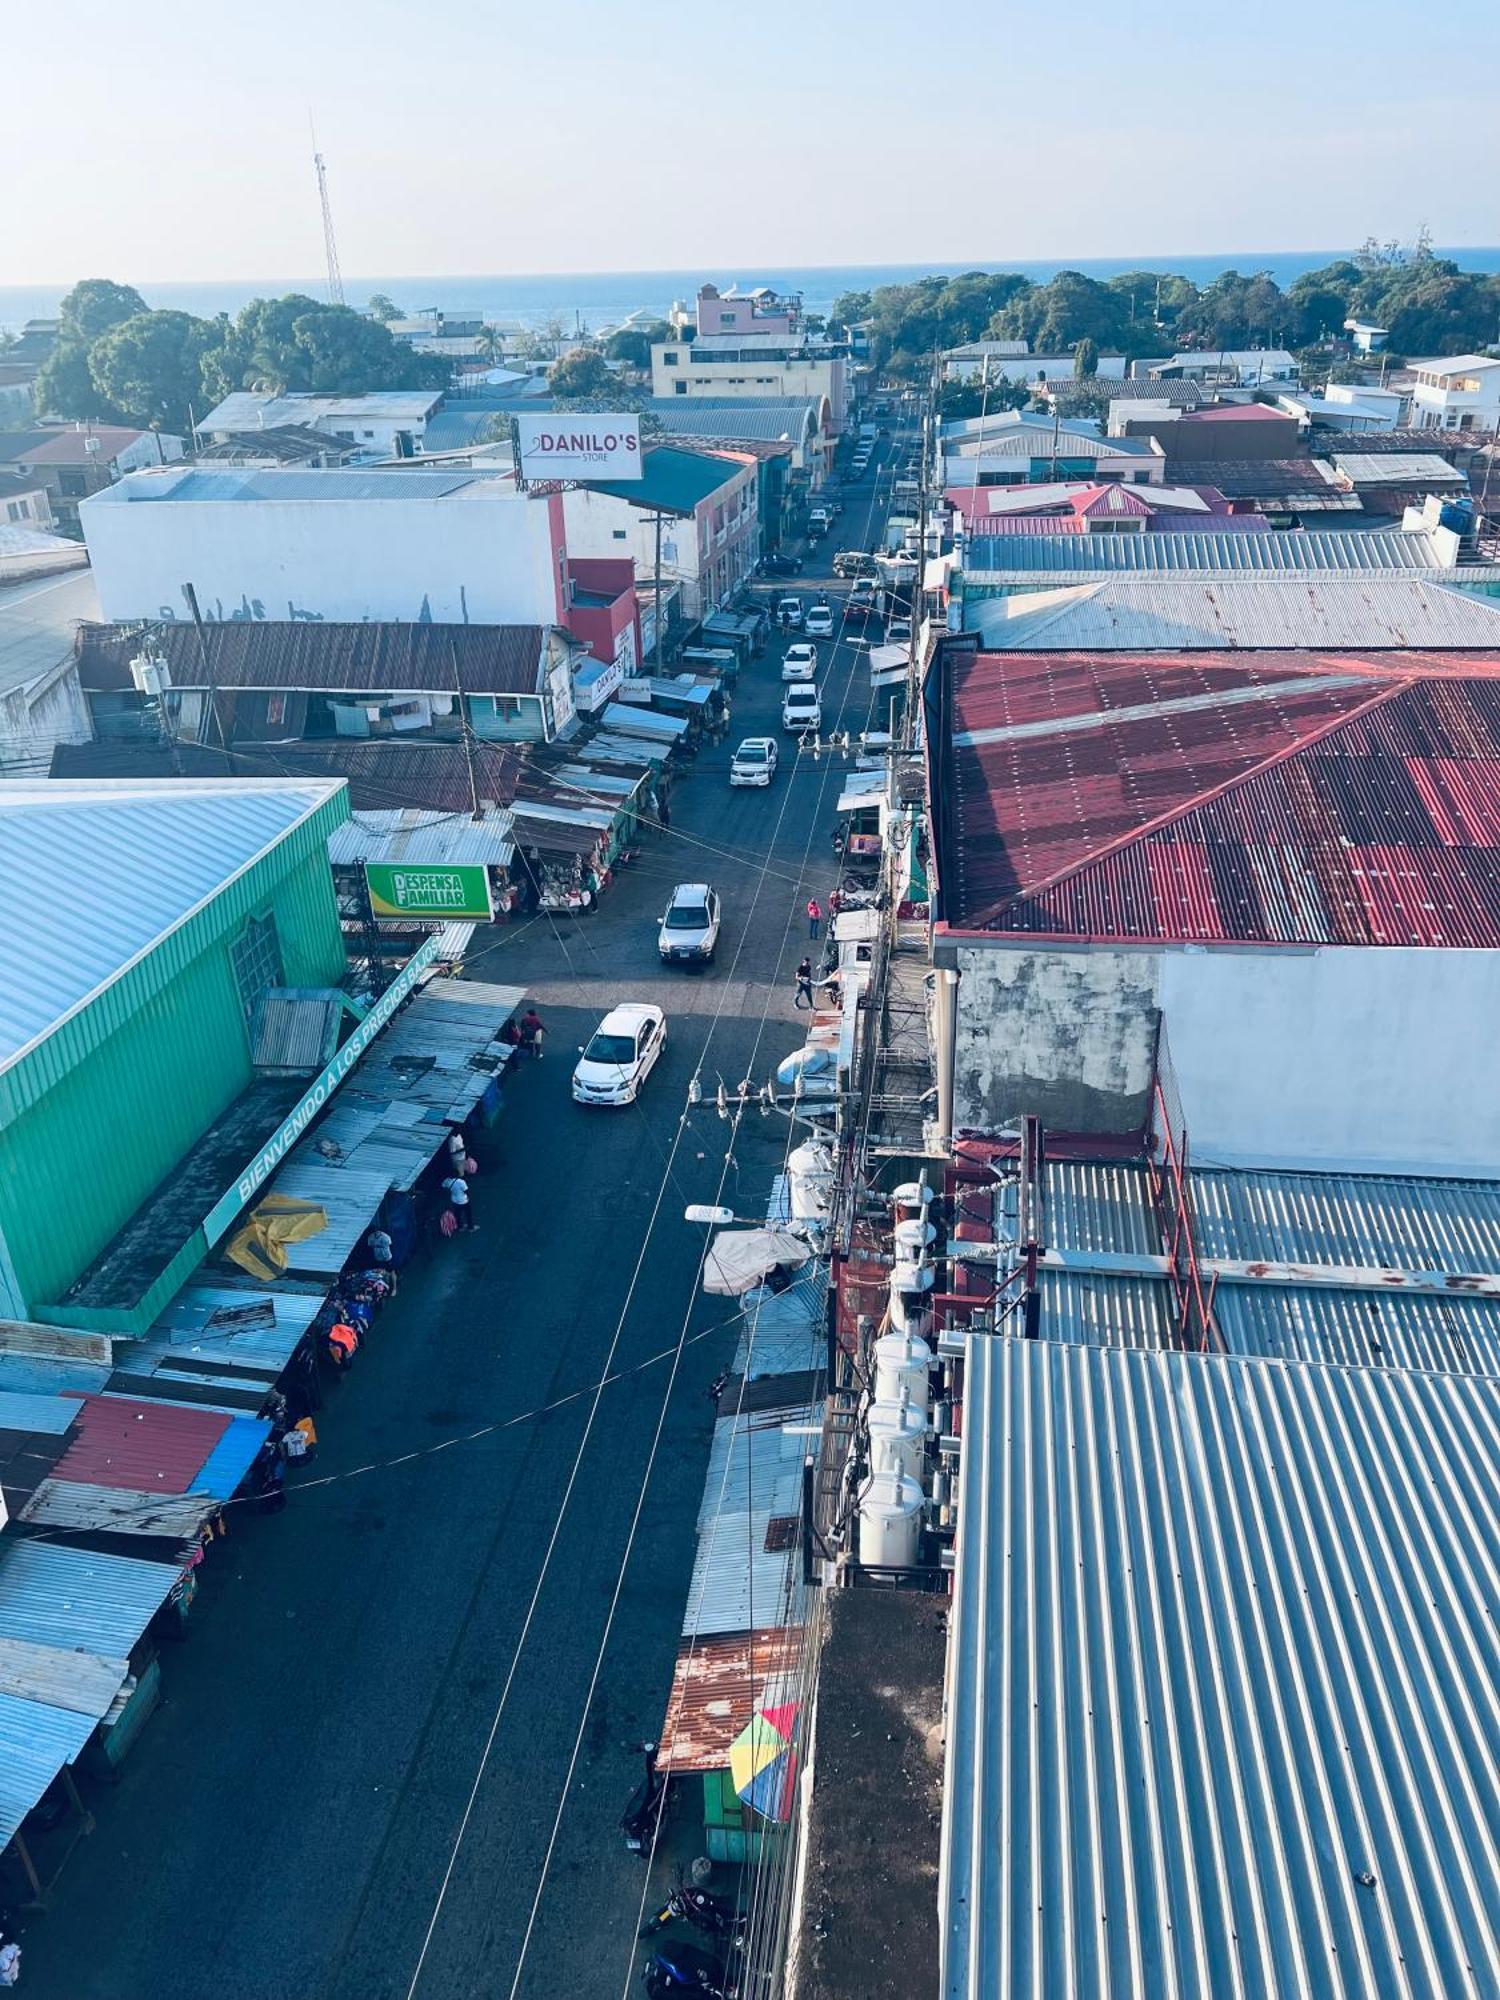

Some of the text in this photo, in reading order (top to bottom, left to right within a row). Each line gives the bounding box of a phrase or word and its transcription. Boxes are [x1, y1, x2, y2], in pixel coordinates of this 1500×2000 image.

[540, 434, 637, 451] DANILO'S
[582, 453, 608, 462] STORE
[394, 873, 461, 890] DESPENSA
[396, 890, 465, 905] FAMILIAR
[239, 940, 438, 1203] BIENVENIDO A LOS PRECIOS BAJOS
